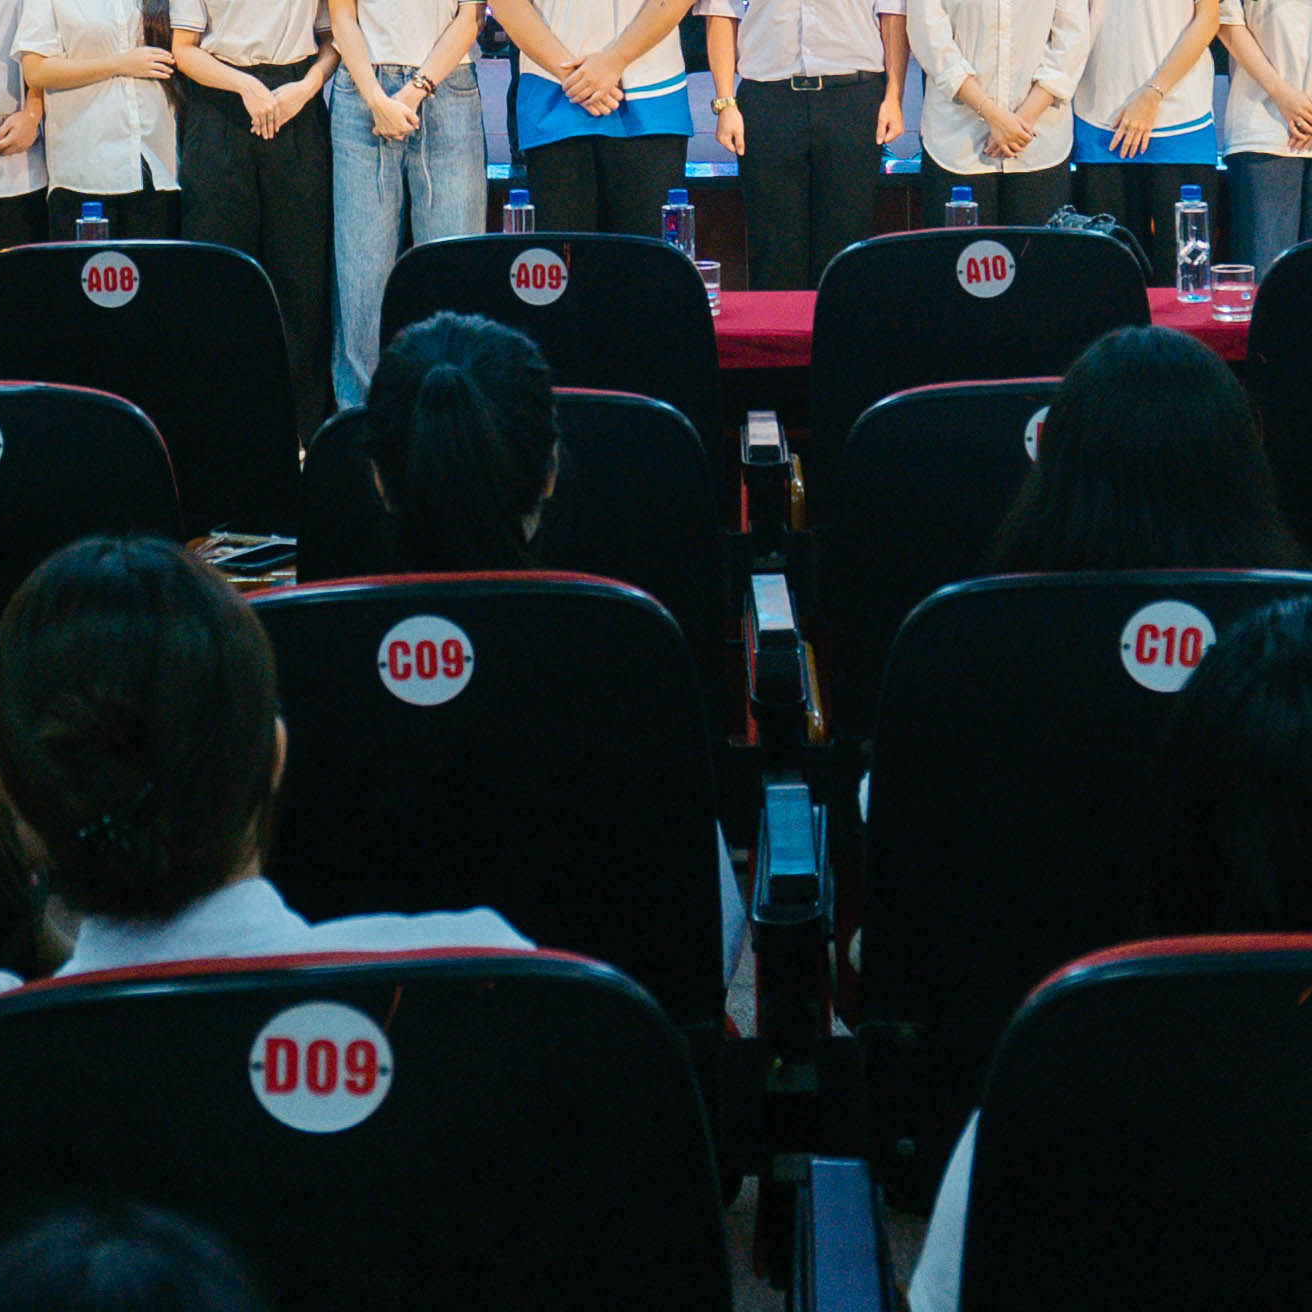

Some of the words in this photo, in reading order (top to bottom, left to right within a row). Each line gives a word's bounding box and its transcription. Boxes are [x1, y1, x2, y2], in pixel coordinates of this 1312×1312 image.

[87, 266, 134, 292] A08
[515, 263, 562, 290] A09
[966, 255, 1007, 284] A10
[388, 639, 463, 681] C09
[1135, 624, 1202, 667] C10
[265, 1038, 377, 1095] D09
